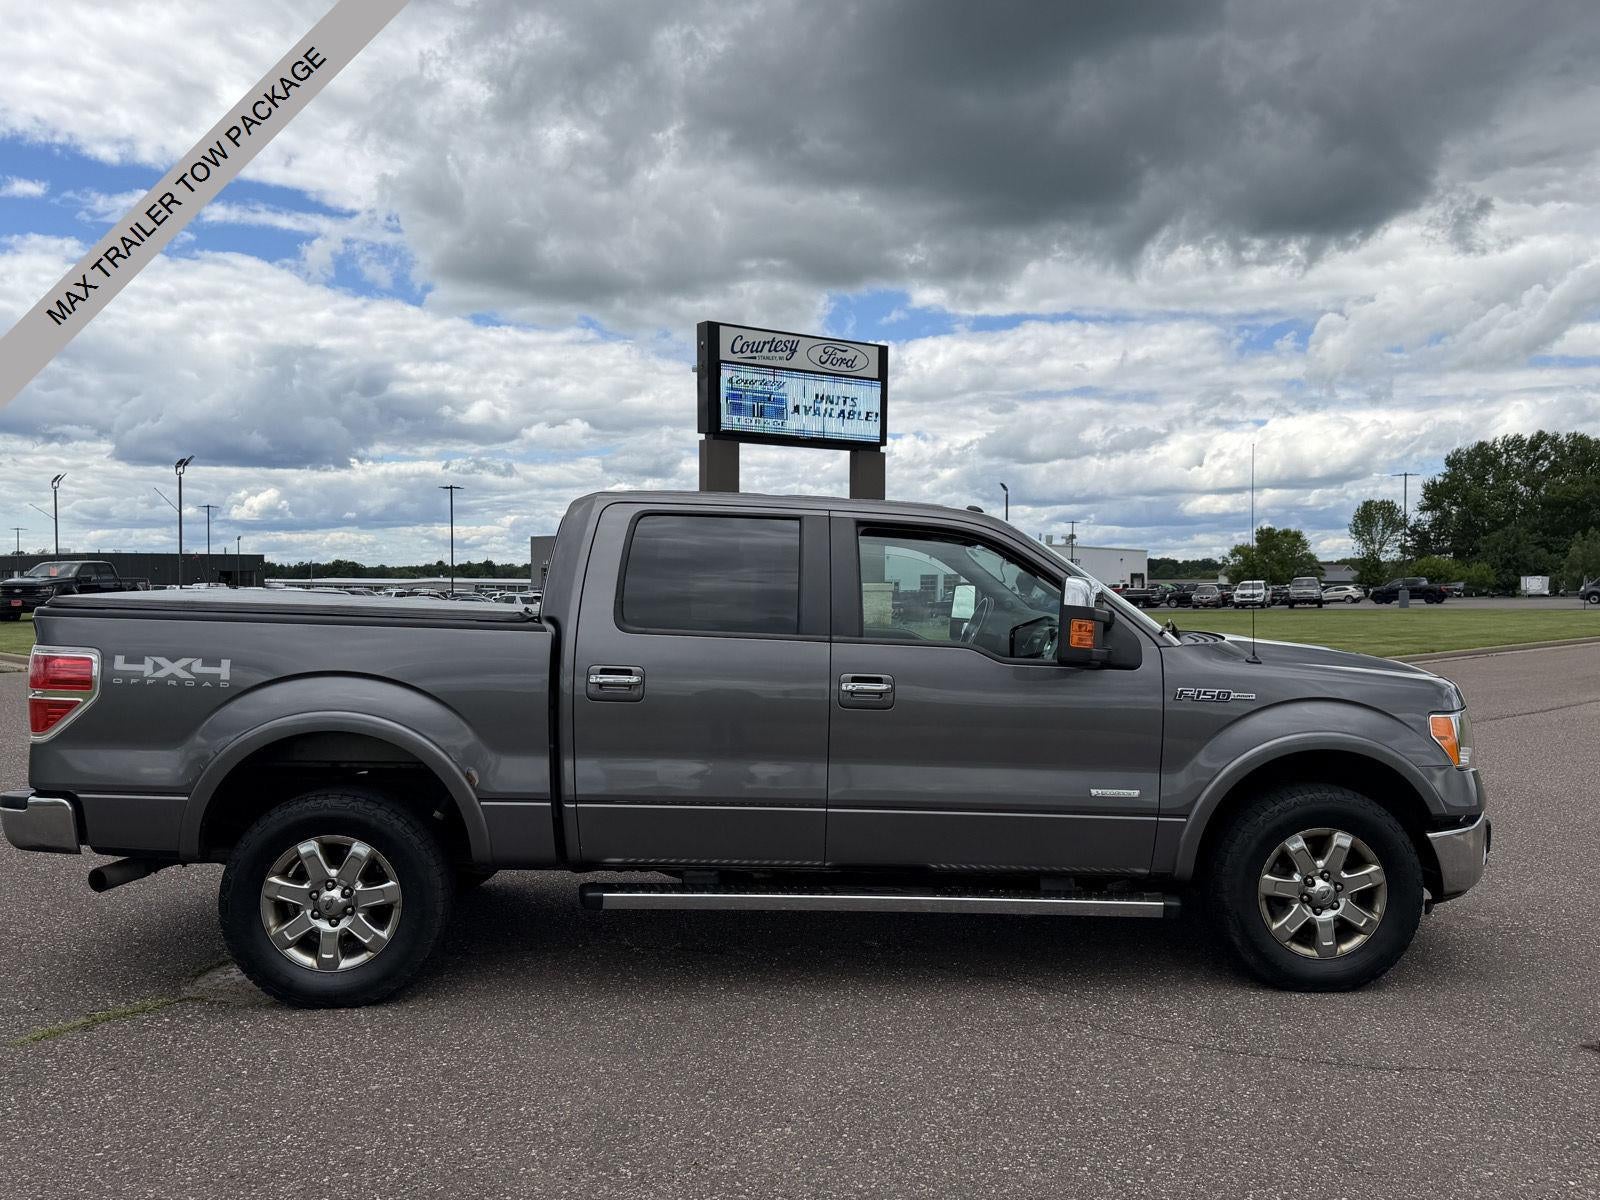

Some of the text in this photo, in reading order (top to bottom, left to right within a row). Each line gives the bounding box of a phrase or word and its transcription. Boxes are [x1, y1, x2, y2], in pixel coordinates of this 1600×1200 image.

[730, 334, 800, 361] Courtesy
[818, 345, 858, 369] Ford
[814, 393, 858, 407] UNITS
[167, 680, 230, 688] ROAD
[1175, 687, 1233, 702] F-150
